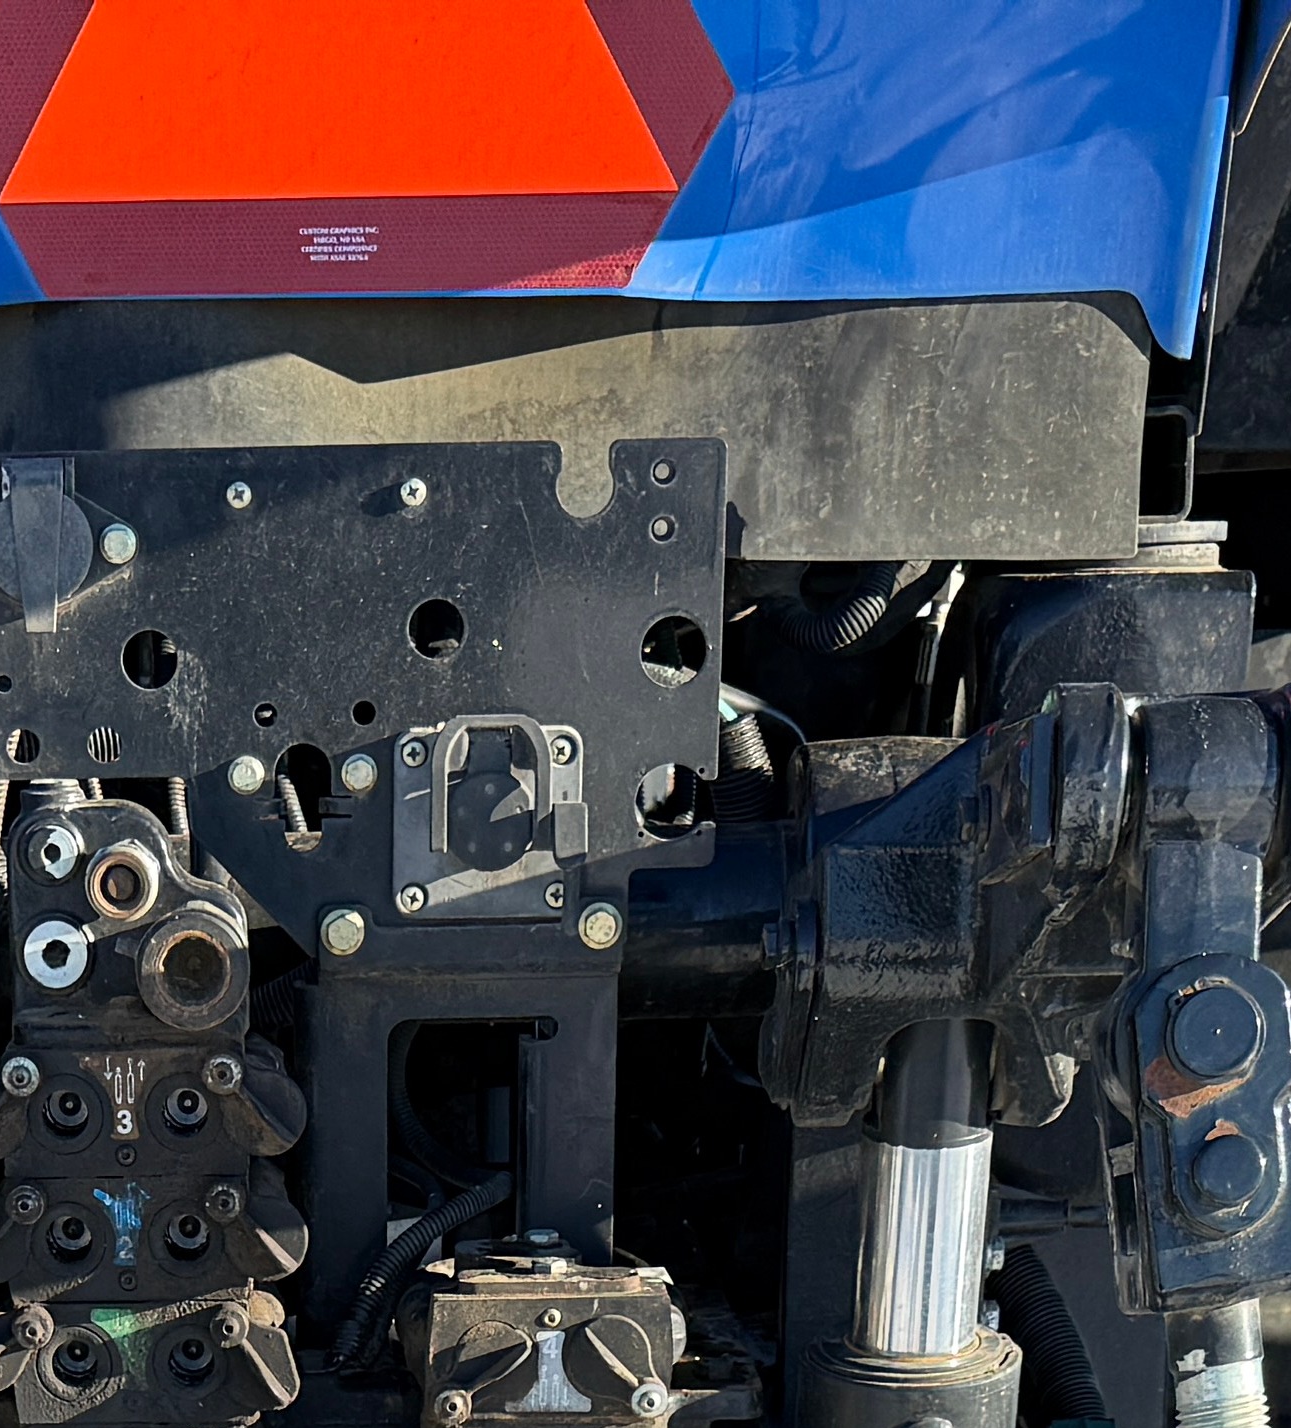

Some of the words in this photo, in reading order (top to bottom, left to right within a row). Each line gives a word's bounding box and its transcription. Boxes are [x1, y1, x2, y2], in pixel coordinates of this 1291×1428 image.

[116, 1110, 134, 1135] 3
[118, 1235, 135, 1260] 2
[542, 1336, 559, 1359] 4
